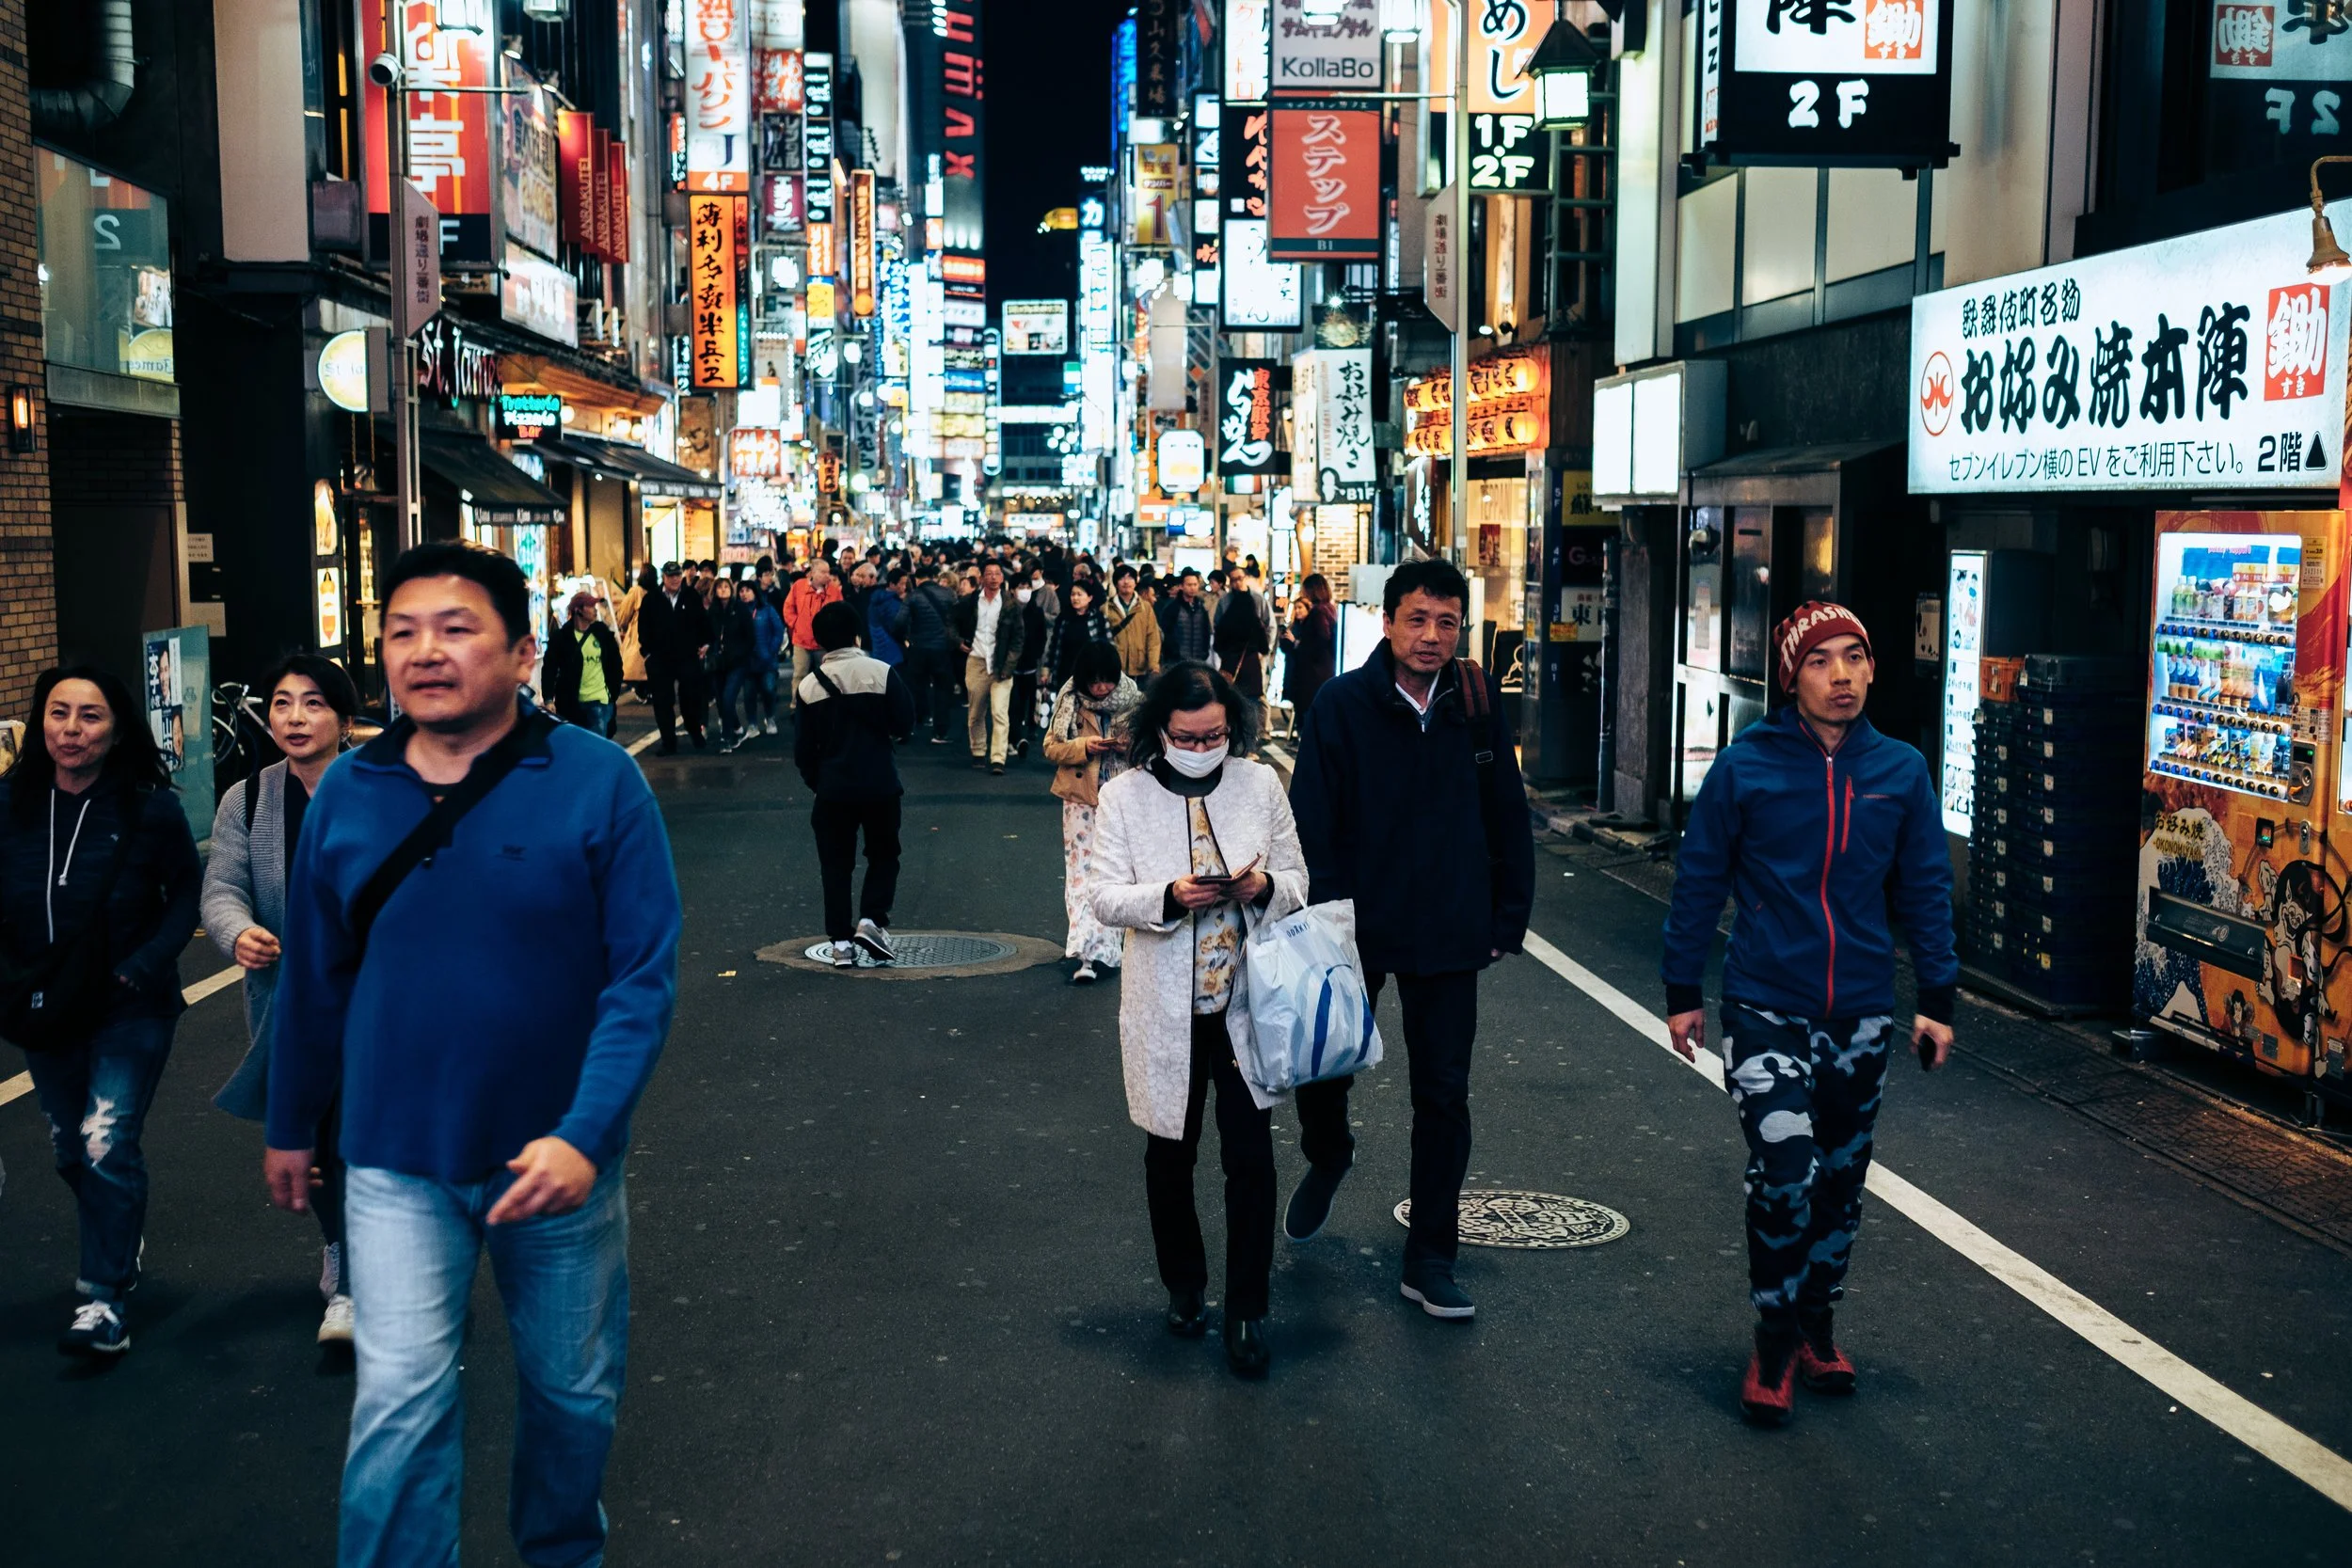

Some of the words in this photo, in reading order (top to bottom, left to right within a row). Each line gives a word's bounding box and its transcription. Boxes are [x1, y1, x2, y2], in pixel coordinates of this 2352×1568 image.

[1281, 57, 1375, 77] KollaBo
[1475, 114, 1534, 149] 1F
[702, 172, 735, 191] 4F
[1301, 115, 1351, 235] ステップ
[1471, 155, 1534, 188] 2F
[579, 157, 591, 239] ANRAKUTEI
[1963, 278, 2081, 340] 歌舞伎町名物
[1961, 301, 2250, 436] お好み焼本陣
[1336, 360, 1371, 468] お好み焼き
[2077, 447, 2101, 476] EV
[2259, 432, 2303, 472] 2階
[1346, 487, 1375, 500] B1F
[2154, 811, 2205, 841] お好み焼
